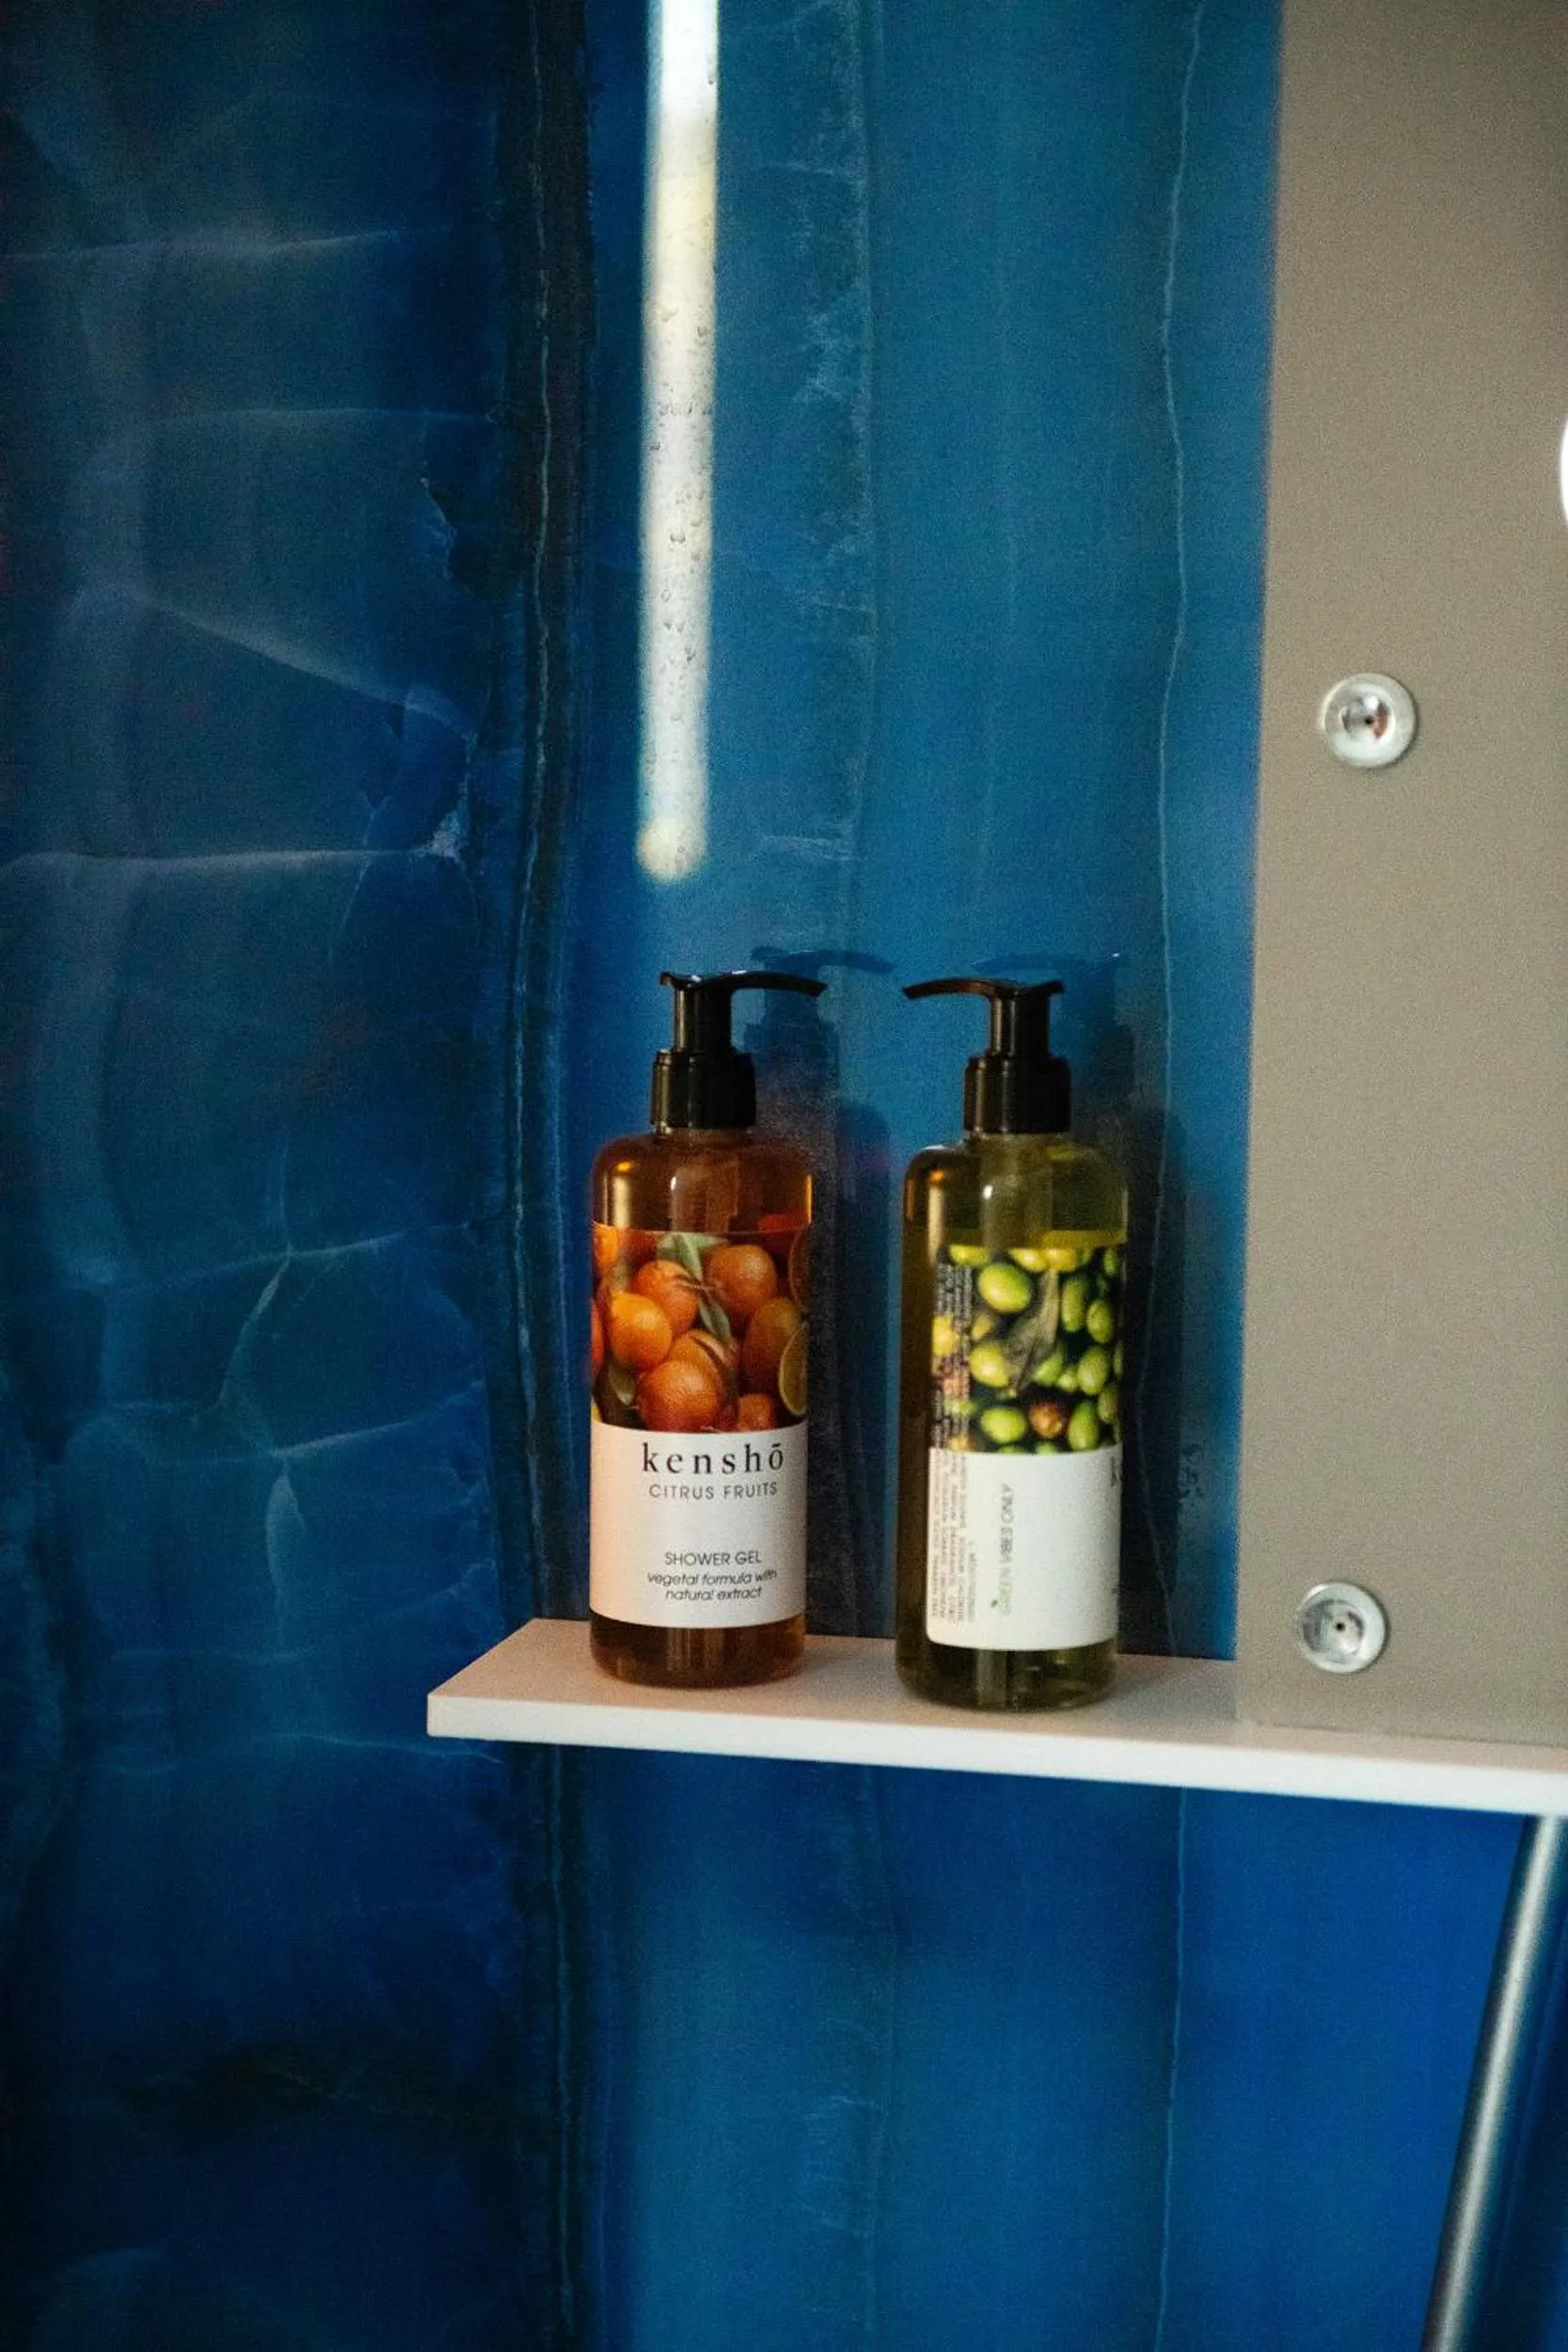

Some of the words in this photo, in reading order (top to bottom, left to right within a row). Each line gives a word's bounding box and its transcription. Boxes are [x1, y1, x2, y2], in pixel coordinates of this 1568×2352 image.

[643, 1442, 784, 1474] kenshō
[649, 1484, 714, 1500] CITRUS
[724, 1482, 778, 1499] FRUITS
[664, 1552, 730, 1565] SHOWER
[735, 1551, 762, 1564] GEL
[647, 1572, 699, 1587] vegetal
[702, 1572, 752, 1585] formula
[754, 1569, 778, 1581] with
[666, 1588, 714, 1601] natural
[718, 1587, 762, 1600] extract
